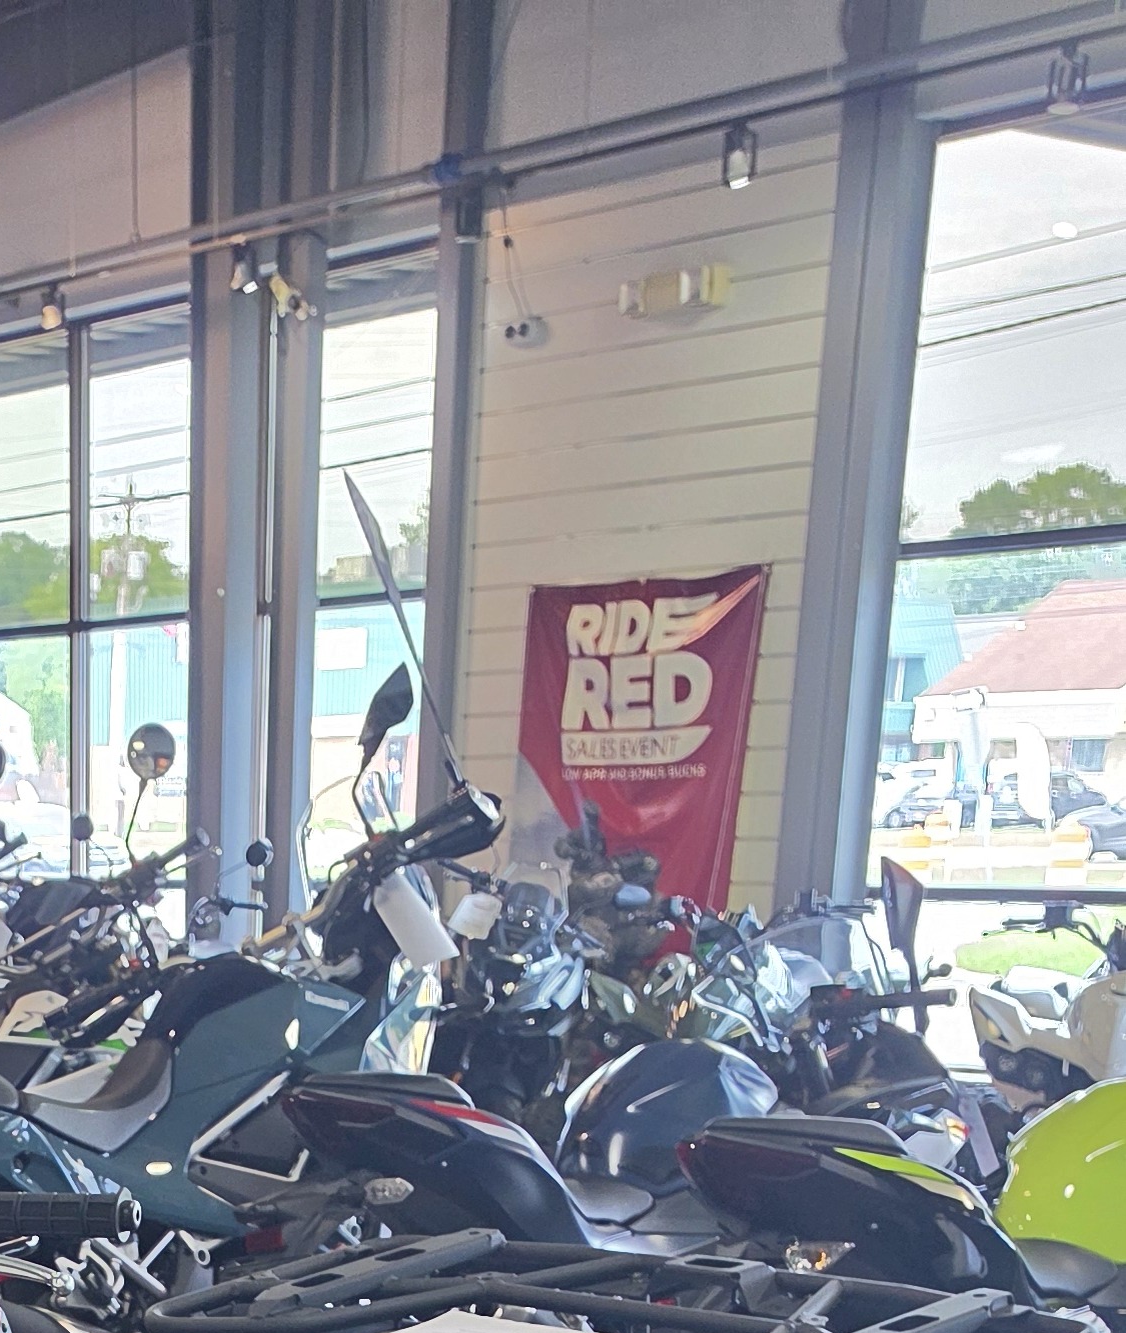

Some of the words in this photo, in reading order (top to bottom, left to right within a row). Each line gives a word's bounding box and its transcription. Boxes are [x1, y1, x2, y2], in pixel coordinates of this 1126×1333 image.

[566, 592, 720, 656] RIDE
[561, 651, 713, 730] RED
[566, 738, 616, 760] SALES
[619, 734, 680, 759] EVENT
